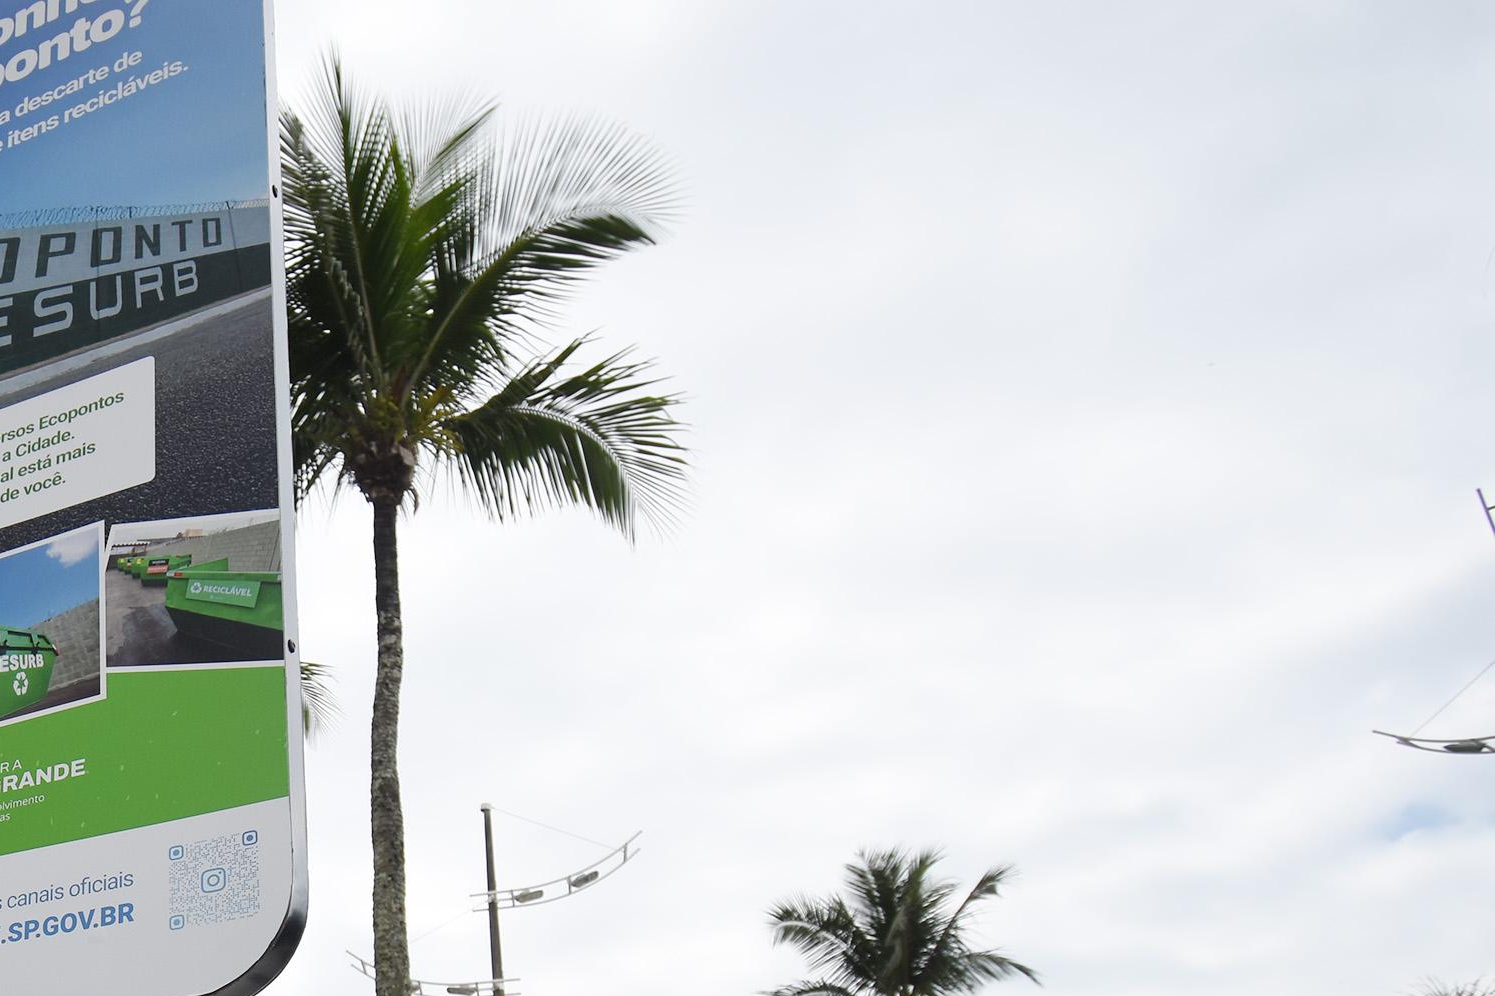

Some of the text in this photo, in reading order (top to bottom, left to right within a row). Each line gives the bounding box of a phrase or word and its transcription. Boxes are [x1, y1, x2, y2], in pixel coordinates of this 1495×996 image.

[15, 65, 109, 117] descarte
[113, 51, 142, 73] de
[8, 115, 59, 148] itens
[64, 60, 189, 123] recicláveis.
[39, 392, 124, 429] Ecopontos
[2, 452, 11, 462] a
[15, 430, 75, 457] Cidade.
[18, 454, 52, 477] está
[56, 442, 96, 464] mais
[0, 488, 19, 503] de
[24, 472, 66, 495] você.
[203, 584, 252, 597] RECICLÁVEL
[7, 884, 64, 908] canais
[69, 872, 134, 897] oficiais
